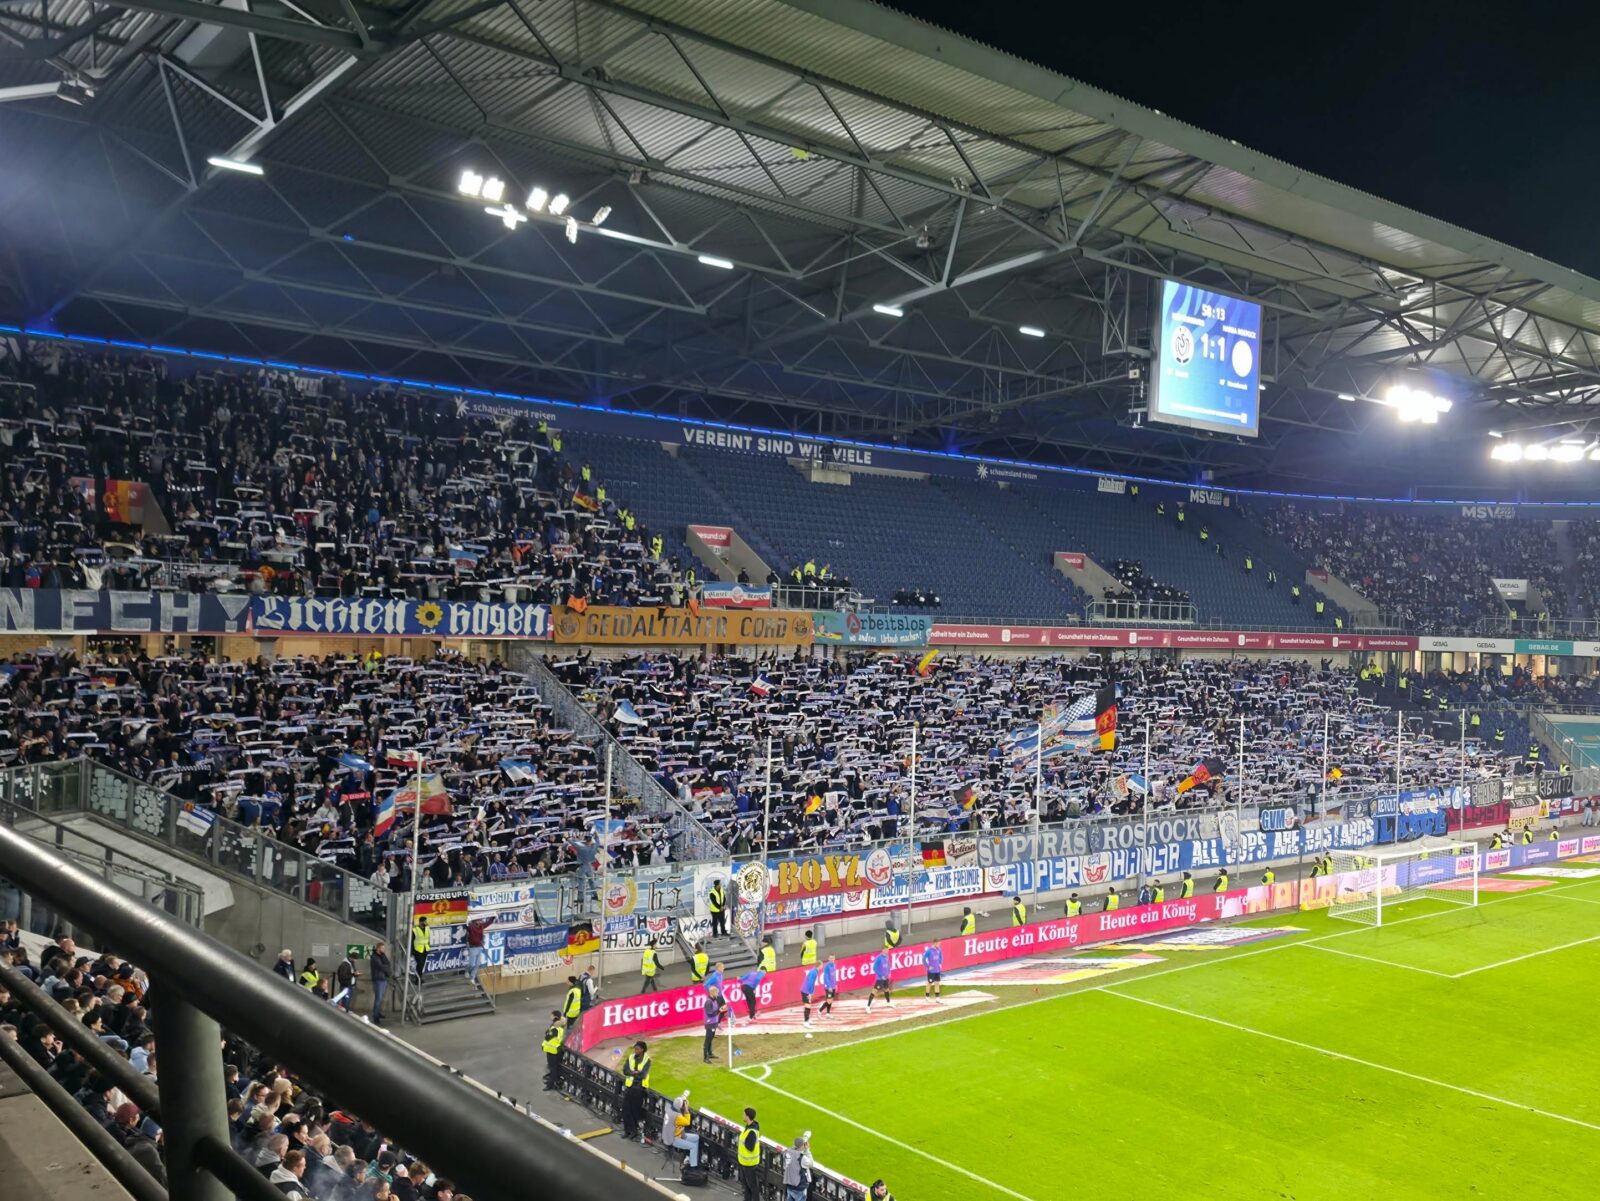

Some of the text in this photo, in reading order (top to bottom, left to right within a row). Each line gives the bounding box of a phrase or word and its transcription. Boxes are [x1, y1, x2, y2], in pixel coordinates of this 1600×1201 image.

[1201, 333, 1225, 362] 1:1
[682, 427, 752, 450] VEREINT
[757, 438, 794, 455] SIND
[832, 448, 872, 465] VIELE
[1189, 489, 1214, 504] MSV
[1462, 506, 1500, 519] MSV
[846, 612, 925, 634] Arbeitslos
[880, 633, 899, 643] Urlaub
[899, 630, 922, 642] machen!
[1528, 643, 1559, 651] GEBAG.DE
[978, 816, 1200, 867] SUPTRAS ROSTOCK
[1191, 839, 1220, 868] ALL
[777, 854, 862, 895] BOYZ
[935, 871, 952, 890] KEINE
[953, 868, 980, 888] FREUNDE
[480, 891, 515, 906] DARGUN
[801, 895, 841, 909] WAREN
[1100, 914, 1139, 932] Heute
[1141, 907, 1160, 924] ein
[1162, 900, 1198, 921] König
[963, 921, 1079, 956] Heute ein König
[424, 951, 461, 973] Fischland
[602, 1002, 670, 1028] Heute
[675, 989, 706, 1013] ein
